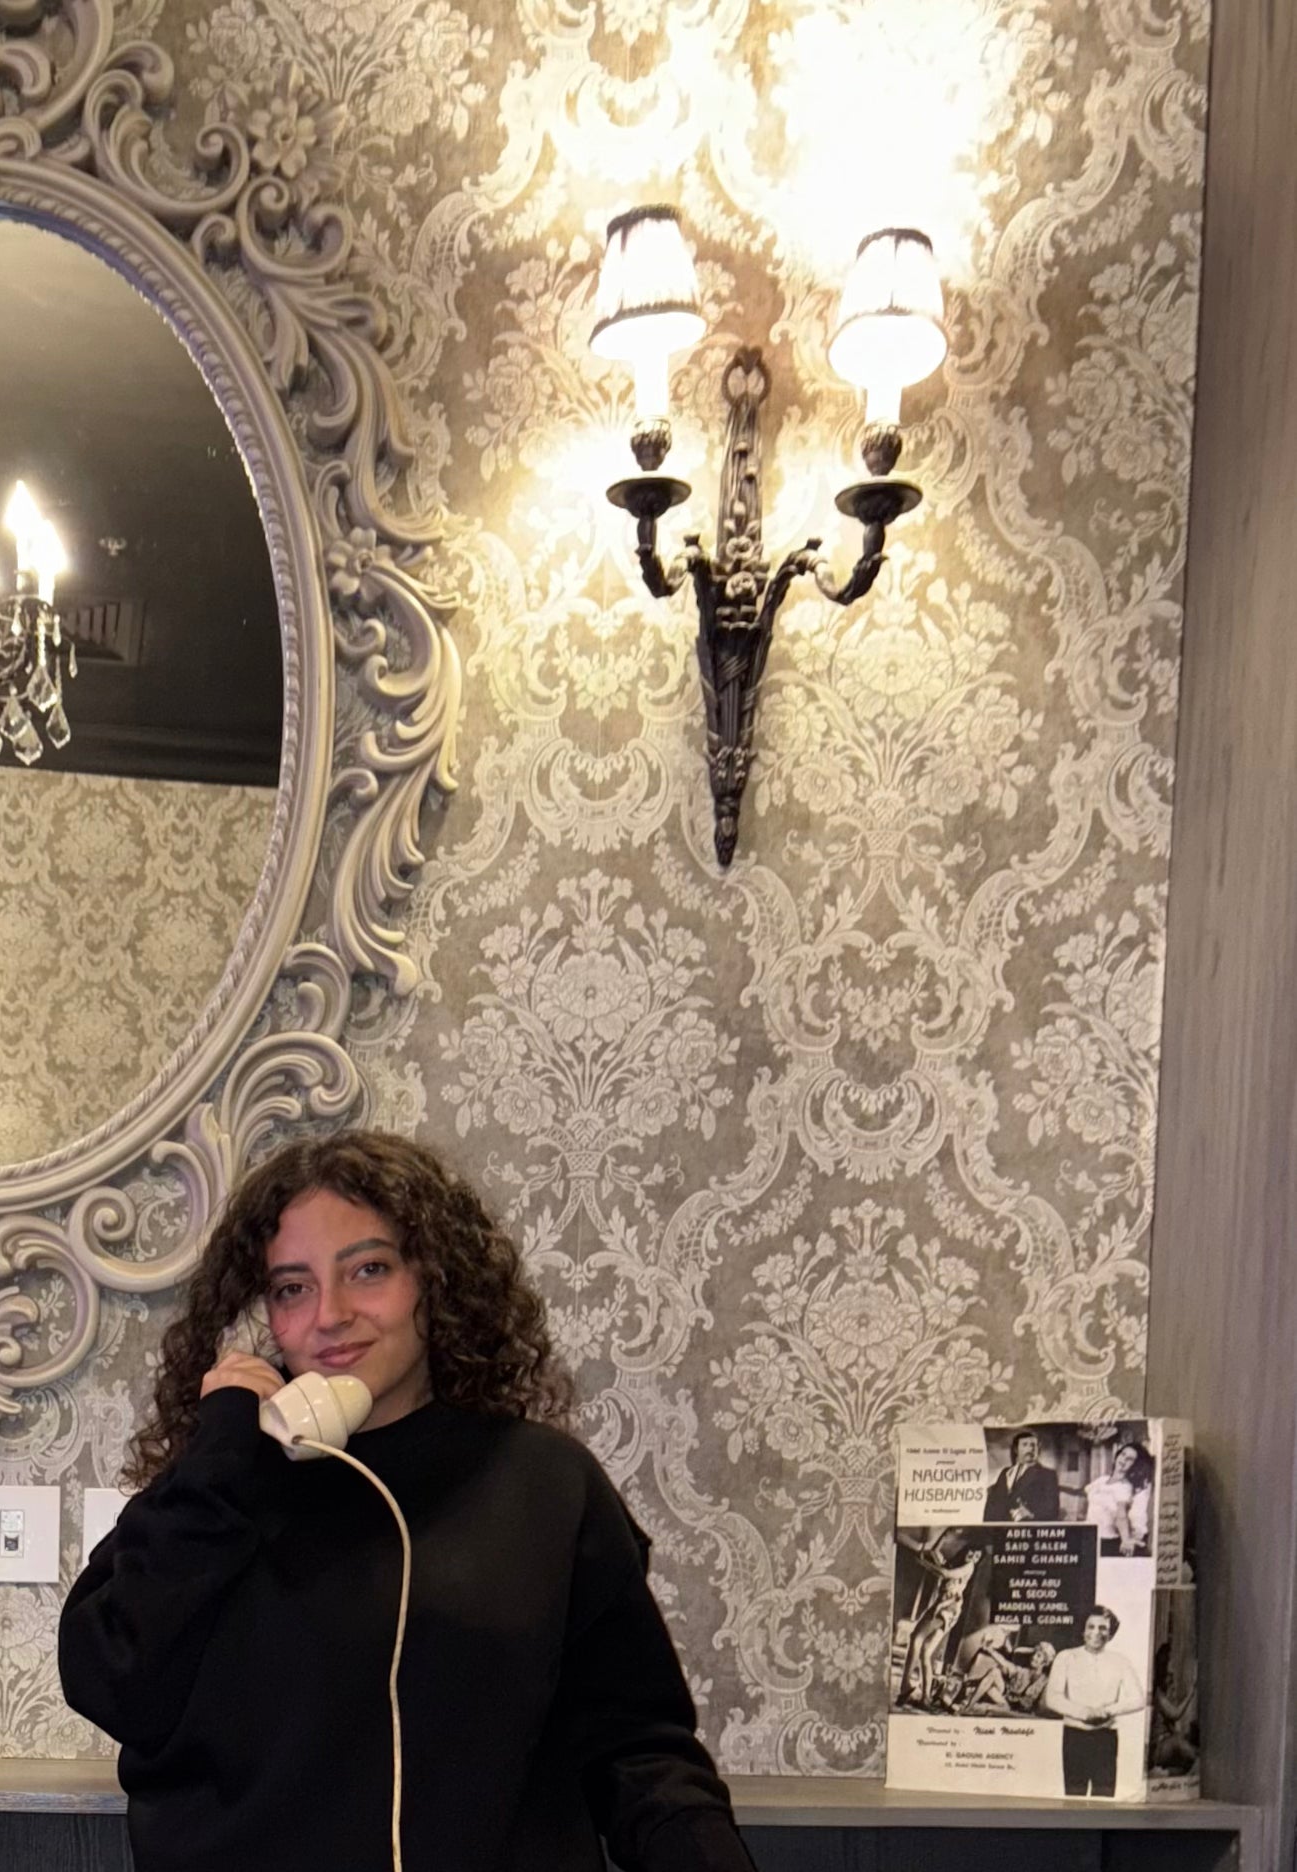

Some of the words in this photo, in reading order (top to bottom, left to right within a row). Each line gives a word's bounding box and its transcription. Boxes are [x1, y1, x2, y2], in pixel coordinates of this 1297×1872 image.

[912, 1469, 982, 1483] NAUGHTY
[904, 1487, 984, 1502] HUSBANDS
[1006, 1529, 1032, 1538] ADEL
[1036, 1528, 1066, 1538] IMAM
[1005, 1541, 1030, 1551] SAID
[1034, 1541, 1068, 1551] SALEH
[993, 1554, 1026, 1564] SAMIR
[1031, 1554, 1079, 1564] GHANEM
[1026, 1589, 1058, 1599] SEOUD
